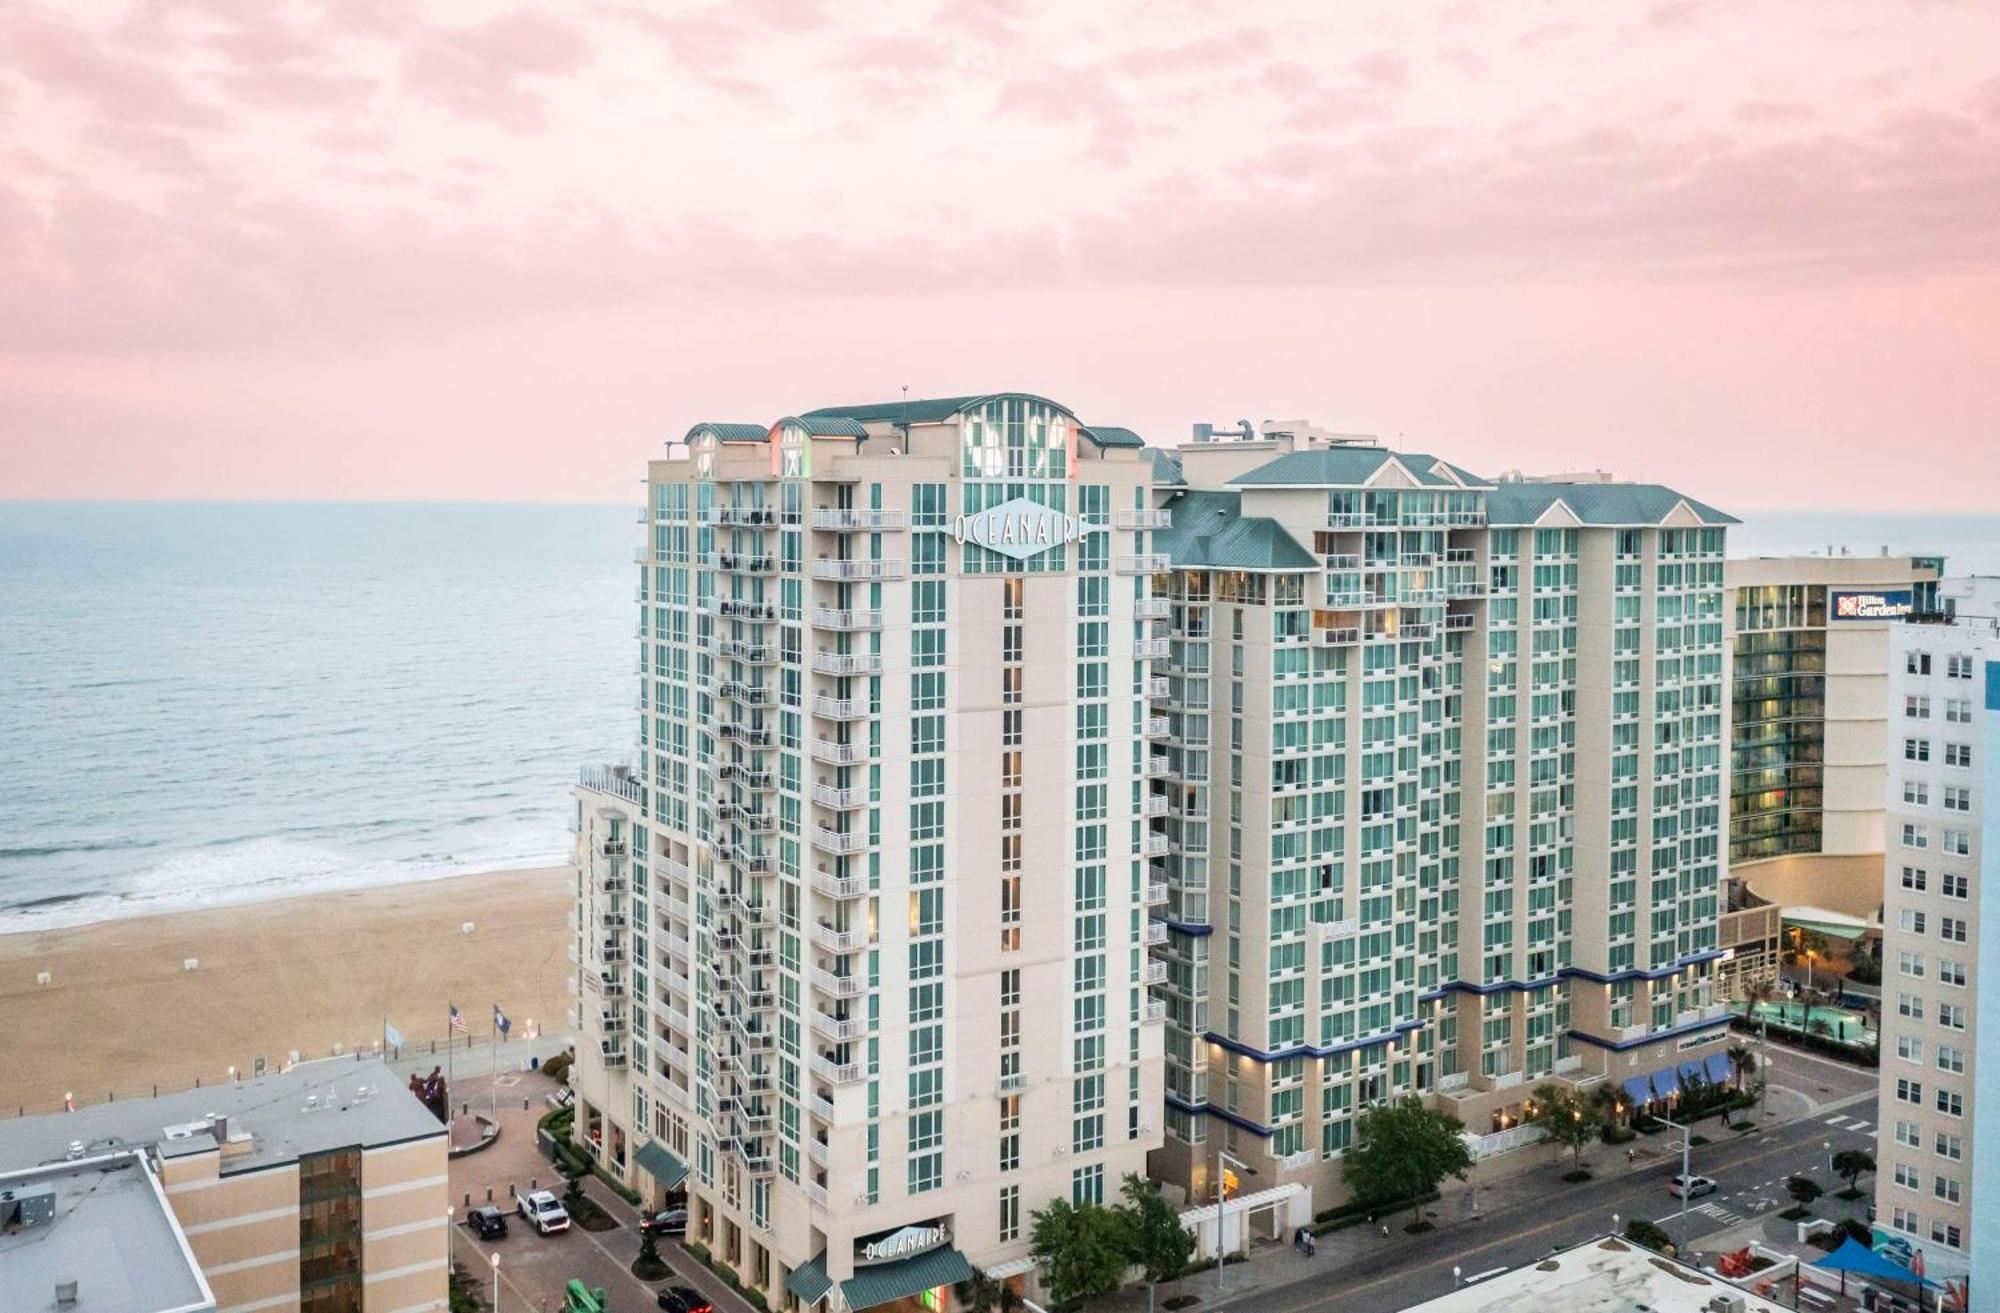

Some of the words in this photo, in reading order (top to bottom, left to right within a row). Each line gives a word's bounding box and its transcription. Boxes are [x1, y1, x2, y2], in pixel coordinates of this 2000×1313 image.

[955, 513, 1087, 545] OCEANAIRE
[1858, 604, 1896, 616] Garden
[866, 1223, 945, 1260] OCEANAIRE
